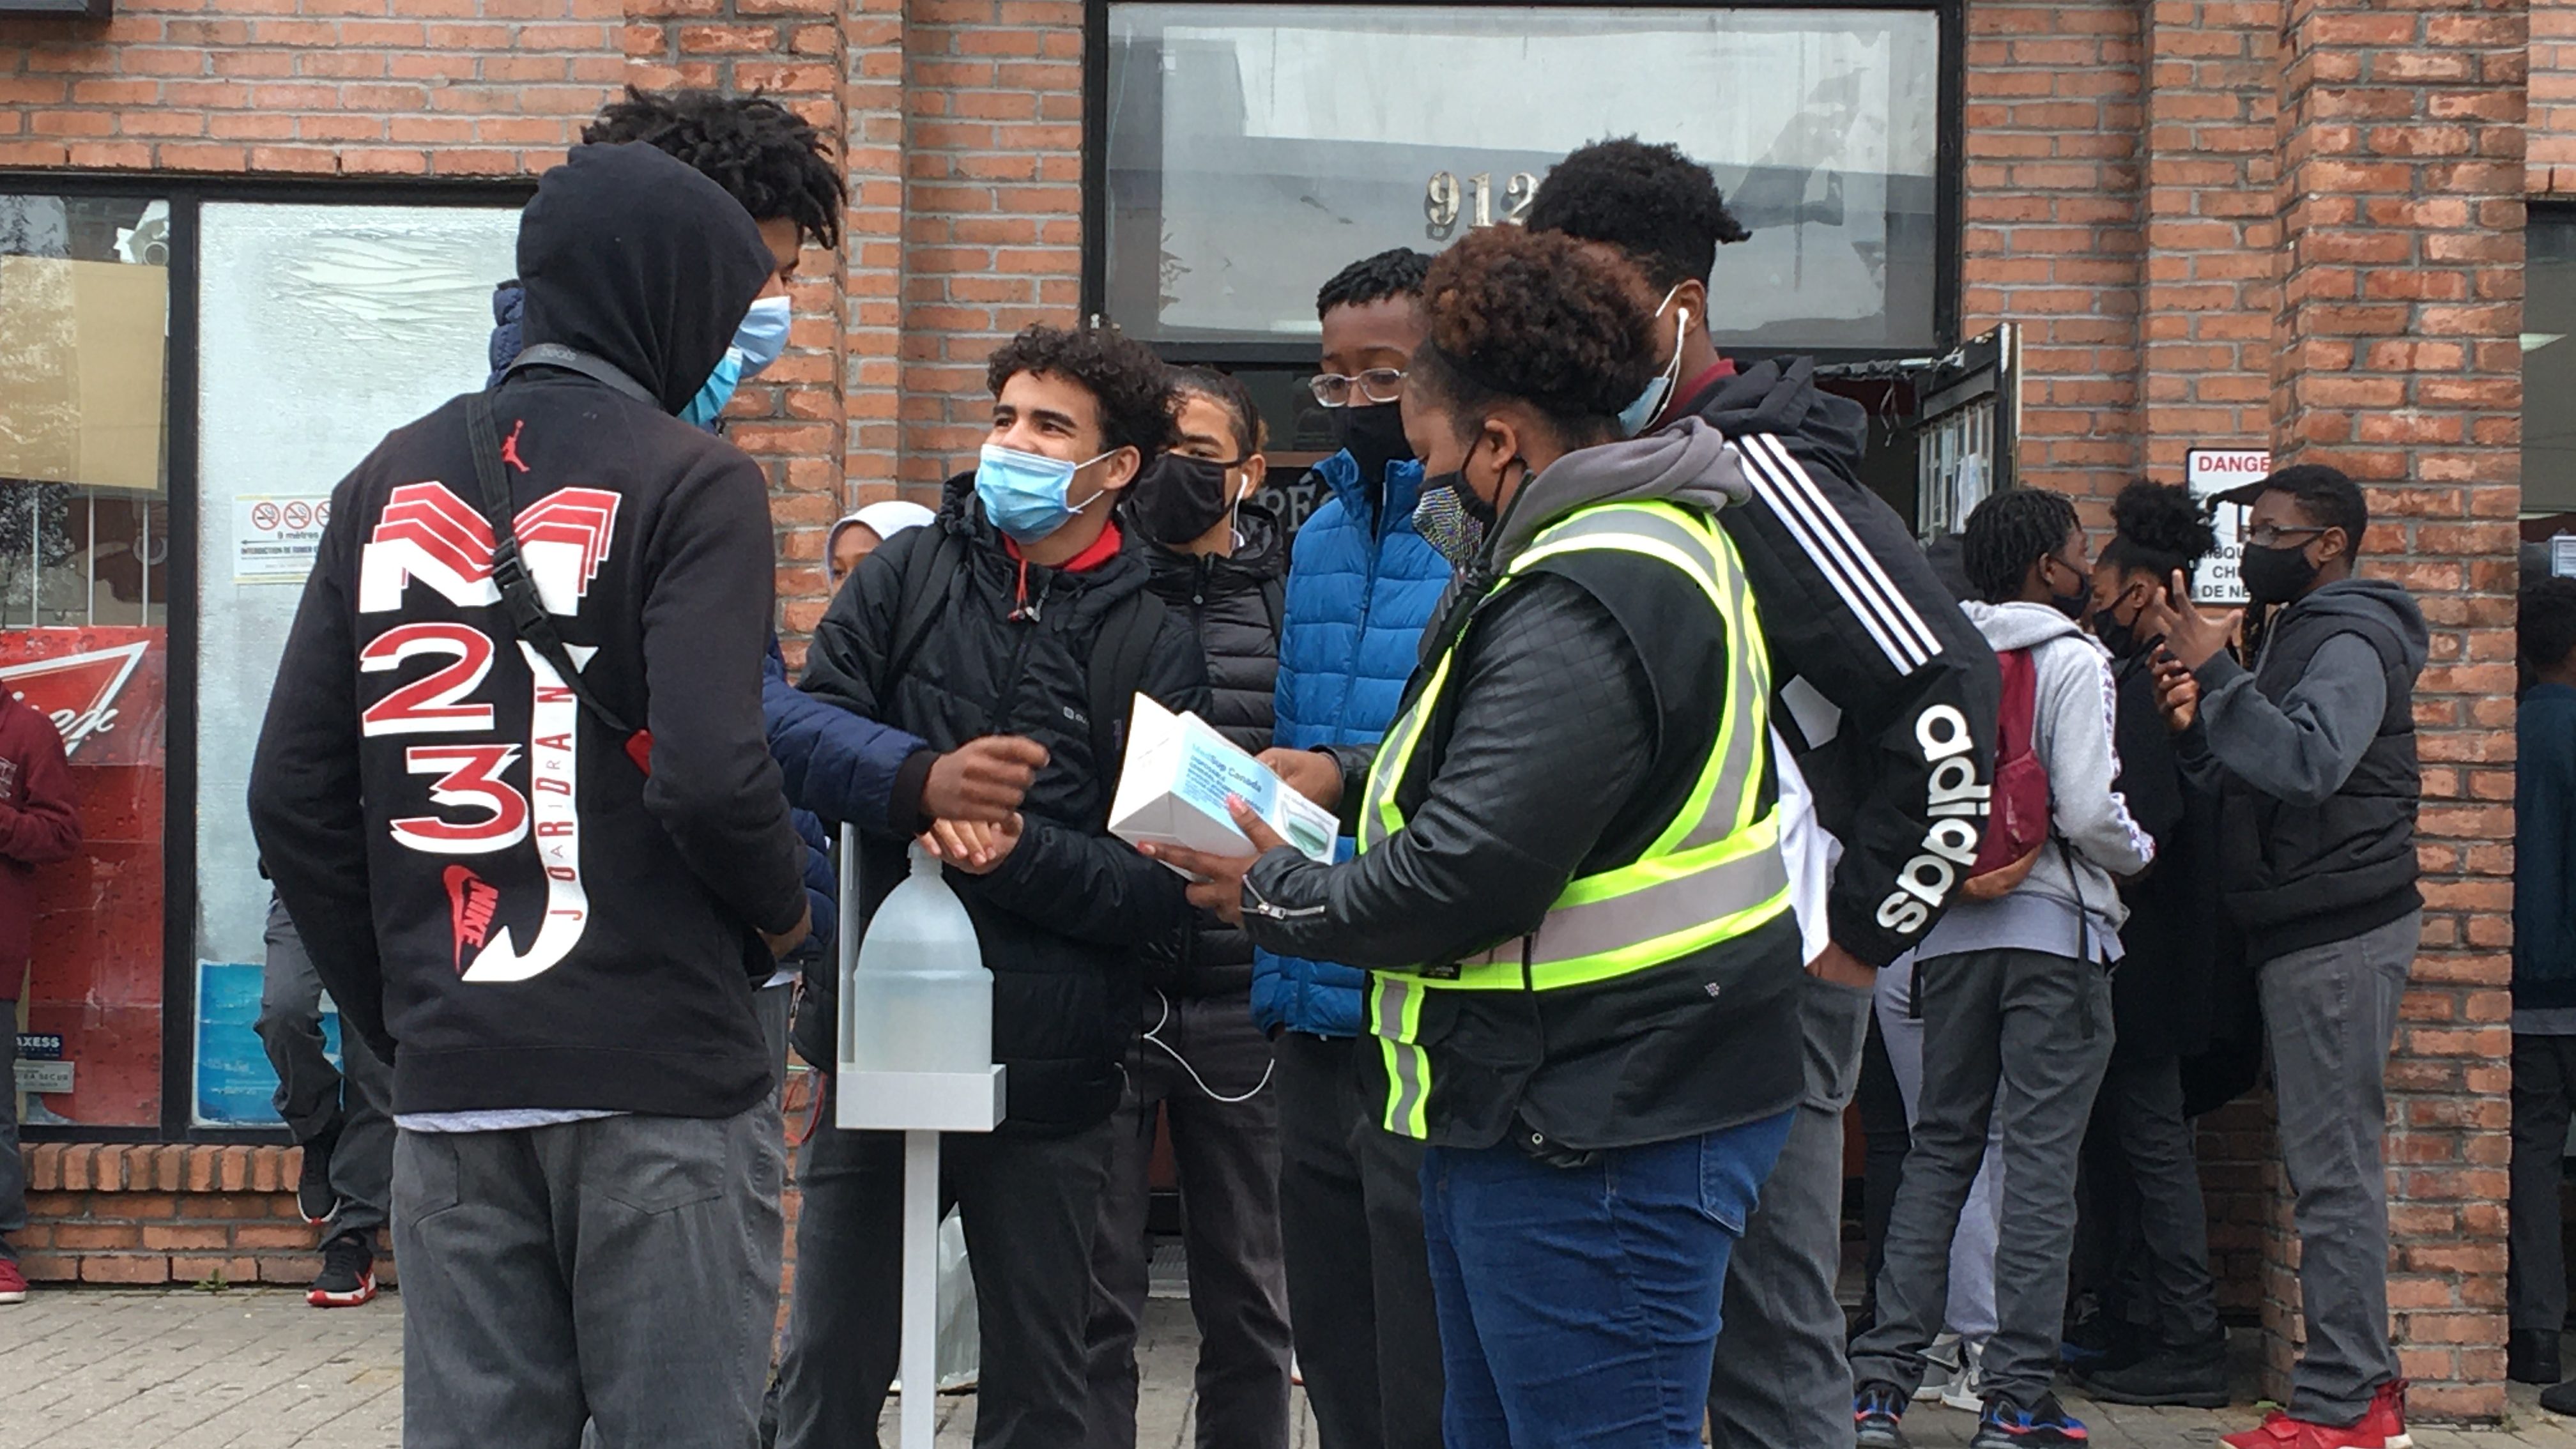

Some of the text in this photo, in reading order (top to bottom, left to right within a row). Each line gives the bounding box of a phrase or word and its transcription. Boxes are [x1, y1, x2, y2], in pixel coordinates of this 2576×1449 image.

[1427, 171, 1540, 227] 912
[2202, 585, 2224, 598] DE
[1228, 767, 1262, 793] Canada
[1876, 704, 1991, 933] adidas
[462, 879, 499, 948] NIKE
